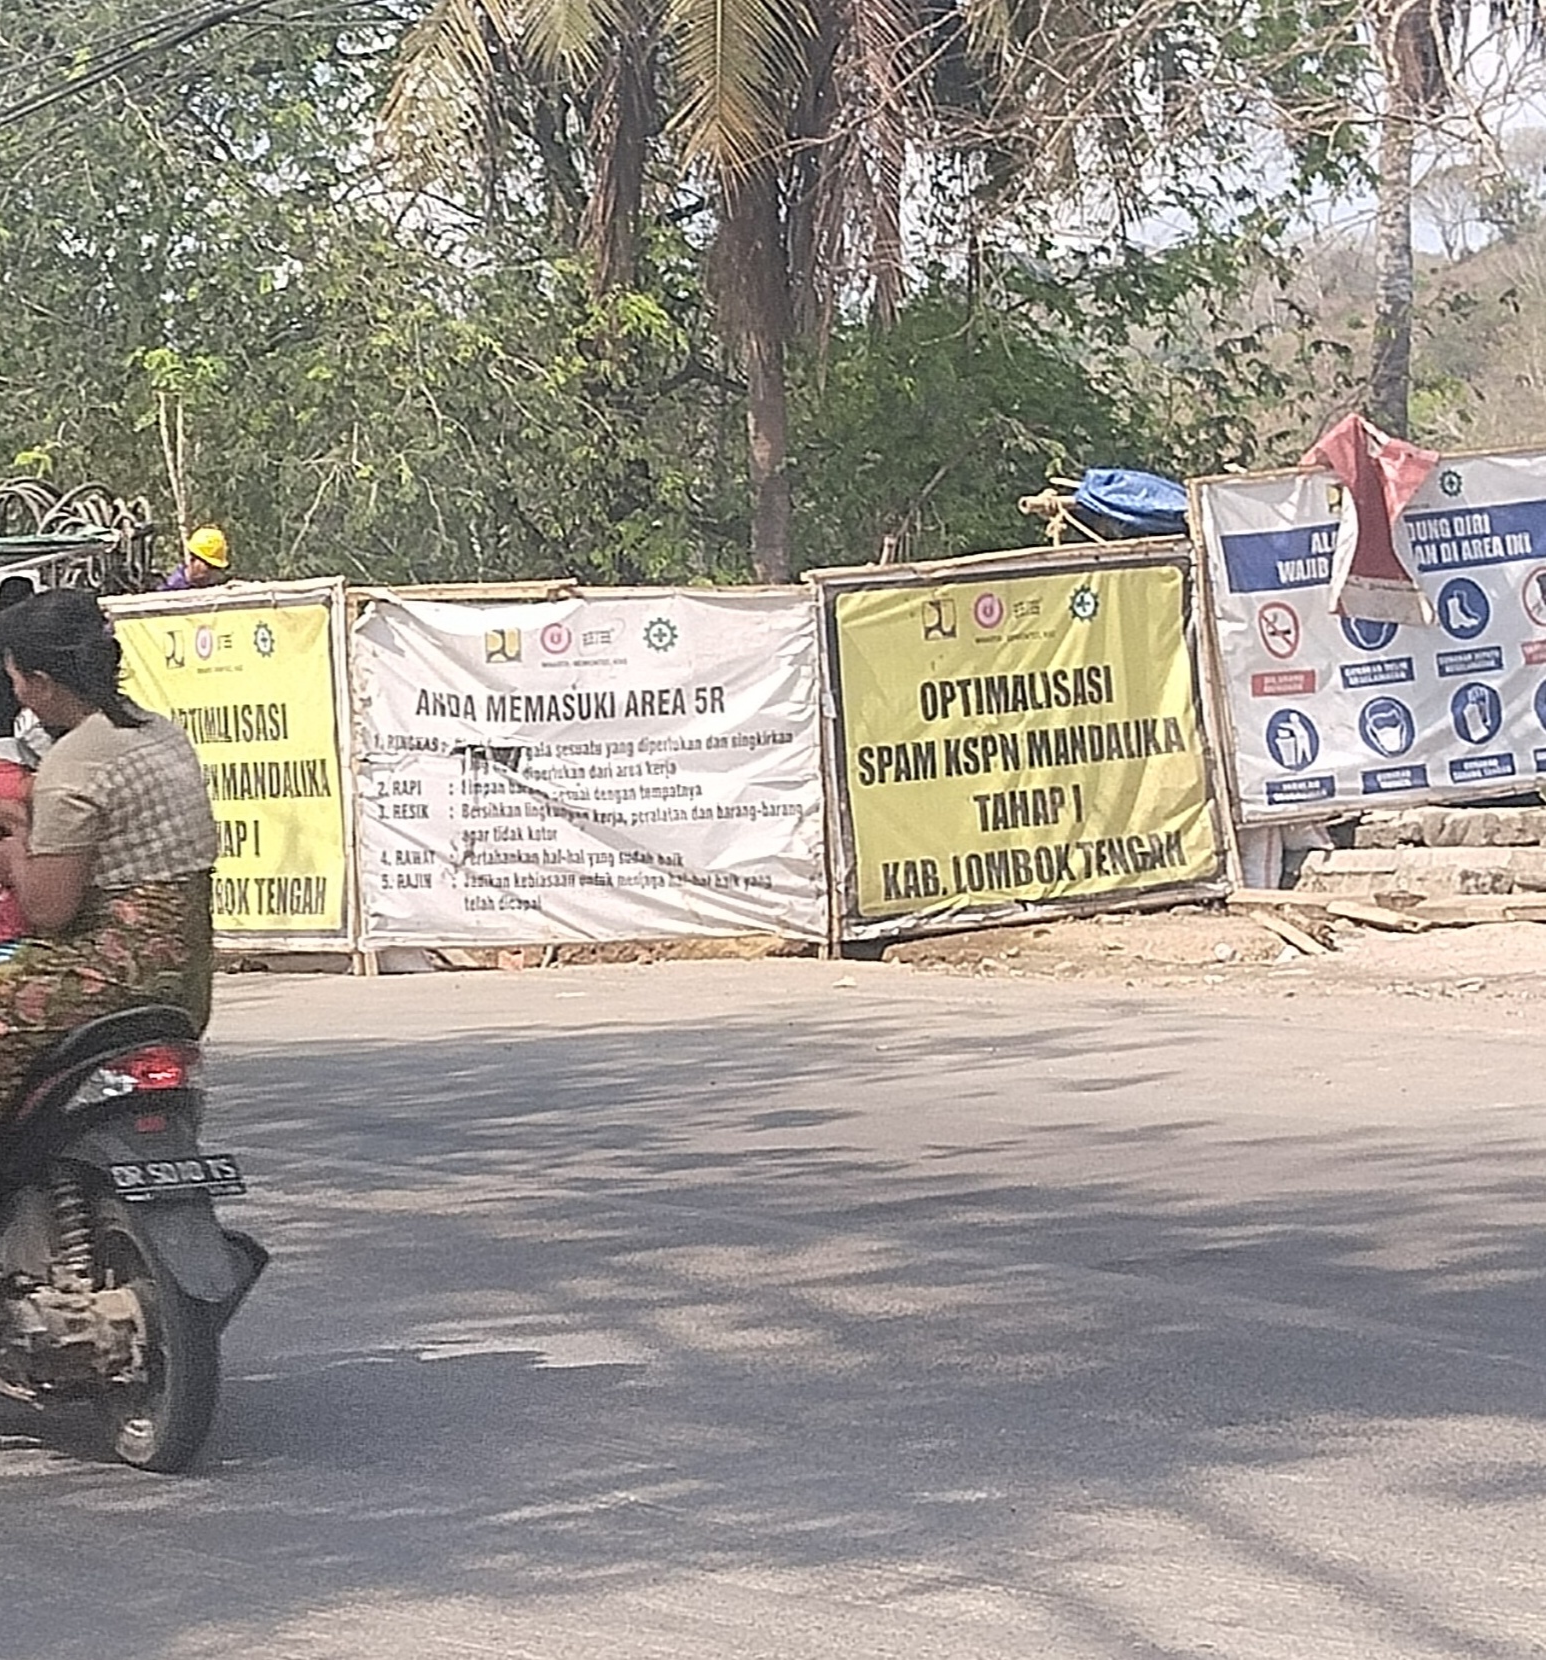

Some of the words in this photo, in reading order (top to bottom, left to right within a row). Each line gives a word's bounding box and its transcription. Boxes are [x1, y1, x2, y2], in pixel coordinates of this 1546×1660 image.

[1455, 512, 1492, 536] DIRI
[1460, 536, 1504, 562] AREA
[1277, 559, 1330, 585] WAJIB
[415, 688, 477, 723] ANDA
[485, 690, 616, 723] MEMASUKI
[624, 687, 687, 718] AREA
[694, 686, 726, 714] 5R
[919, 664, 1114, 722] OPTIMALISASI
[605, 741, 635, 758] yang
[706, 733, 729, 750] dan
[731, 730, 794, 751] singkirkan
[857, 740, 936, 787] SPAM
[943, 732, 1021, 778] KSPN
[1026, 716, 1187, 769] MANDALIKA
[220, 759, 332, 801] MANDALIKA
[589, 762, 613, 780] dari
[645, 760, 677, 779] kerja
[392, 780, 421, 795] RAPI
[594, 787, 636, 804] dengan
[639, 784, 703, 802] tempatnya
[392, 804, 429, 819] RESIK
[461, 803, 521, 820] Bersihkan
[691, 804, 714, 820] dan
[973, 787, 1066, 832] TAHAP
[1074, 783, 1084, 824] I
[253, 819, 260, 858] I
[493, 826, 524, 842] tidak
[528, 826, 558, 842] kotor
[543, 849, 585, 865] hal-hal
[882, 859, 949, 901] KAB.
[952, 843, 1076, 894] LOMBOK
[1074, 831, 1187, 879] TENGAH
[397, 873, 432, 889] RAJIN
[254, 876, 327, 916] TENGAH
[464, 896, 494, 911] telah
